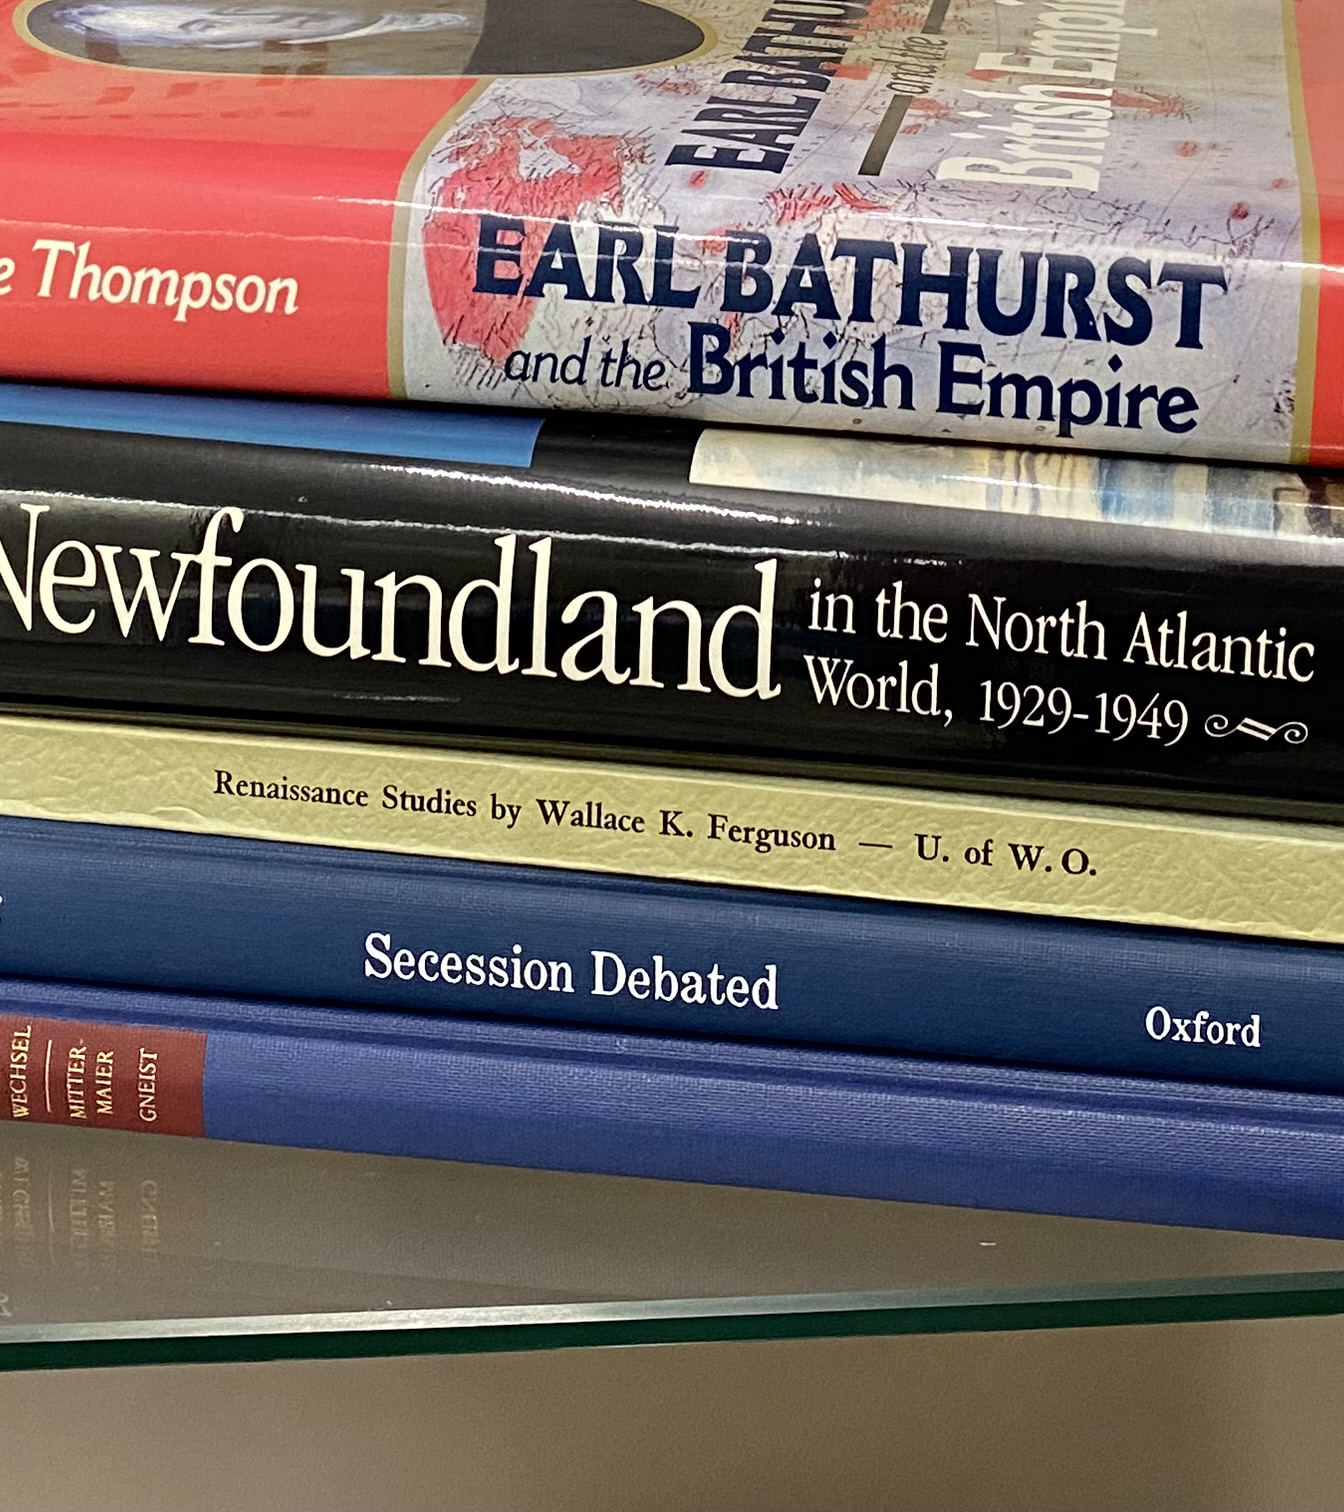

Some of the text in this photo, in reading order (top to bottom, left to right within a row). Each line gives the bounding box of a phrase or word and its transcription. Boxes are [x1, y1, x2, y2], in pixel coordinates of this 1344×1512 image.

[871, 35, 949, 95] and the
[666, 96, 822, 174] EARL
[936, 83, 1114, 192] British
[31, 239, 300, 321] Thompson
[471, 215, 1229, 349] EARL BATHURST
[504, 322, 1199, 438] and the British Empire
[808, 577, 1317, 682] in the North Atlantic
[803, 655, 1189, 746] World, 1929-1949
[214, 769, 370, 810] Renaissance
[381, 786, 477, 819] Studies
[490, 794, 523, 830] by
[535, 798, 646, 835] Wallace
[658, 809, 693, 838] K.
[707, 814, 836, 854] Ferguson
[915, 835, 950, 863] U.
[964, 837, 994, 866] of
[364, 931, 778, 1012] Secession Debated
[1144, 1005, 1261, 1049] Oxford
[10, 1024, 31, 1118] WECHSEL
[96, 1051, 114, 1115] MAIER
[139, 1048, 157, 1121] GNEIST
